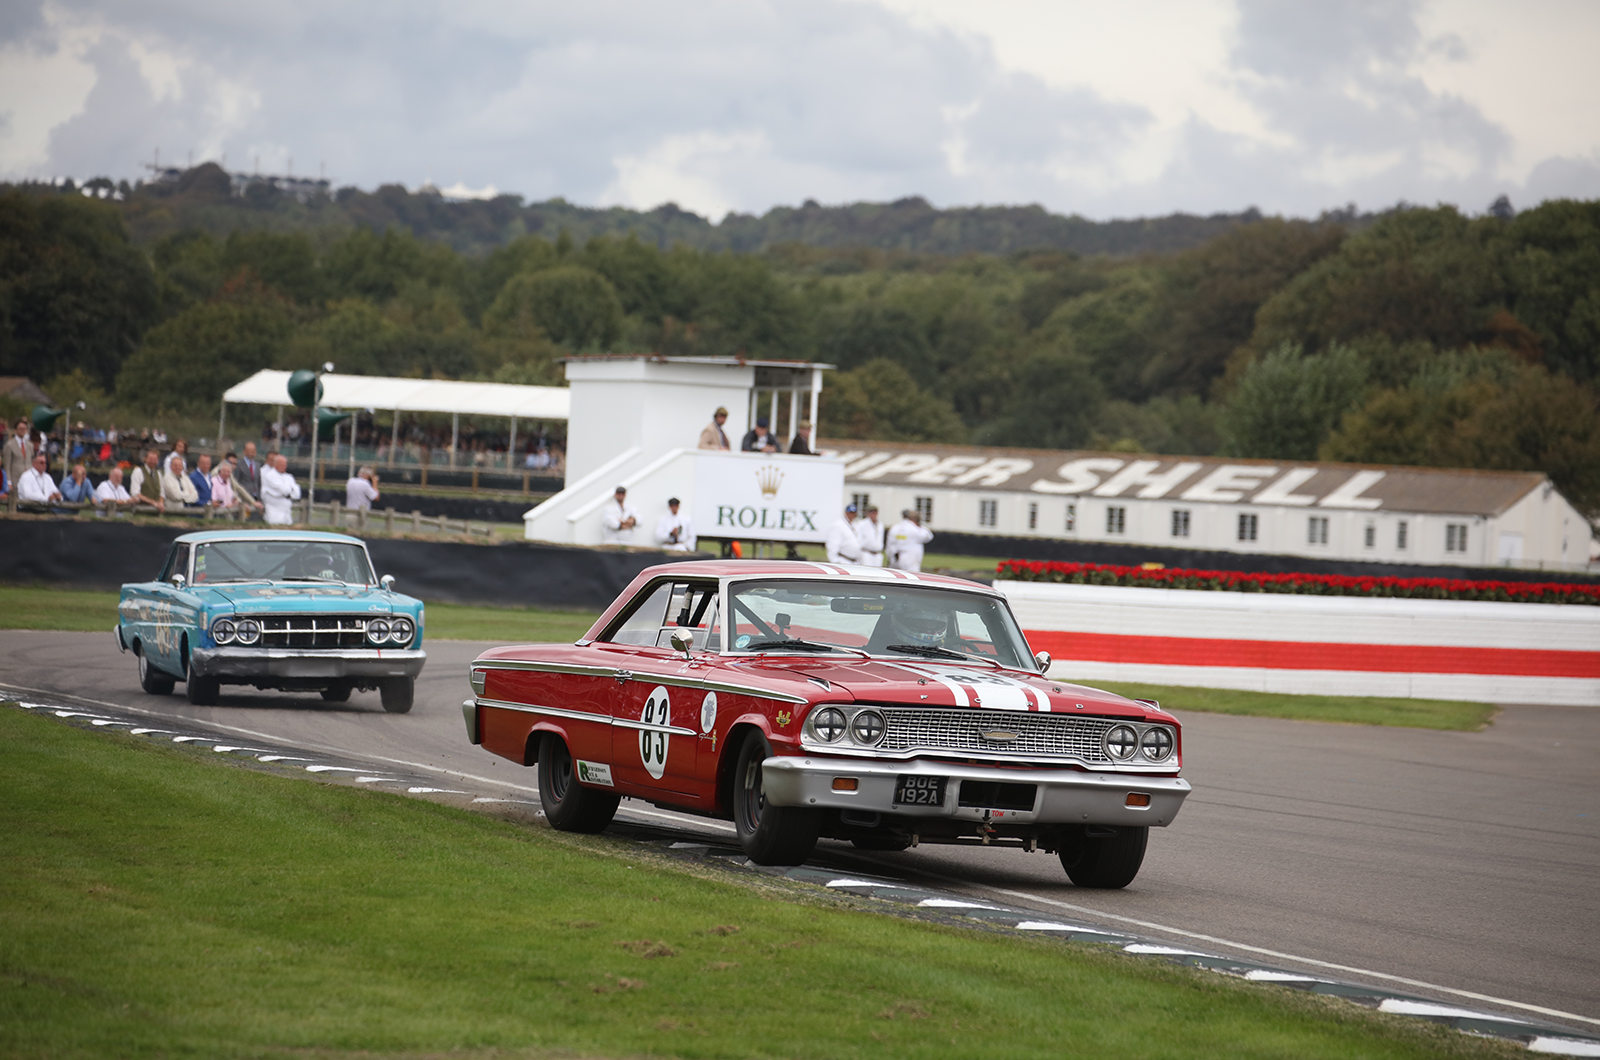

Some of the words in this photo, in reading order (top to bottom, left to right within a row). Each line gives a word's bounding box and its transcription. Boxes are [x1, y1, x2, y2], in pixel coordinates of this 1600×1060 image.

[1031, 458, 1388, 510] SHELL
[716, 505, 818, 532] ROLEX
[945, 674, 1015, 686] 83
[642, 697, 668, 765] 83
[905, 776, 938, 789] BOE
[900, 788, 938, 804] 192A
